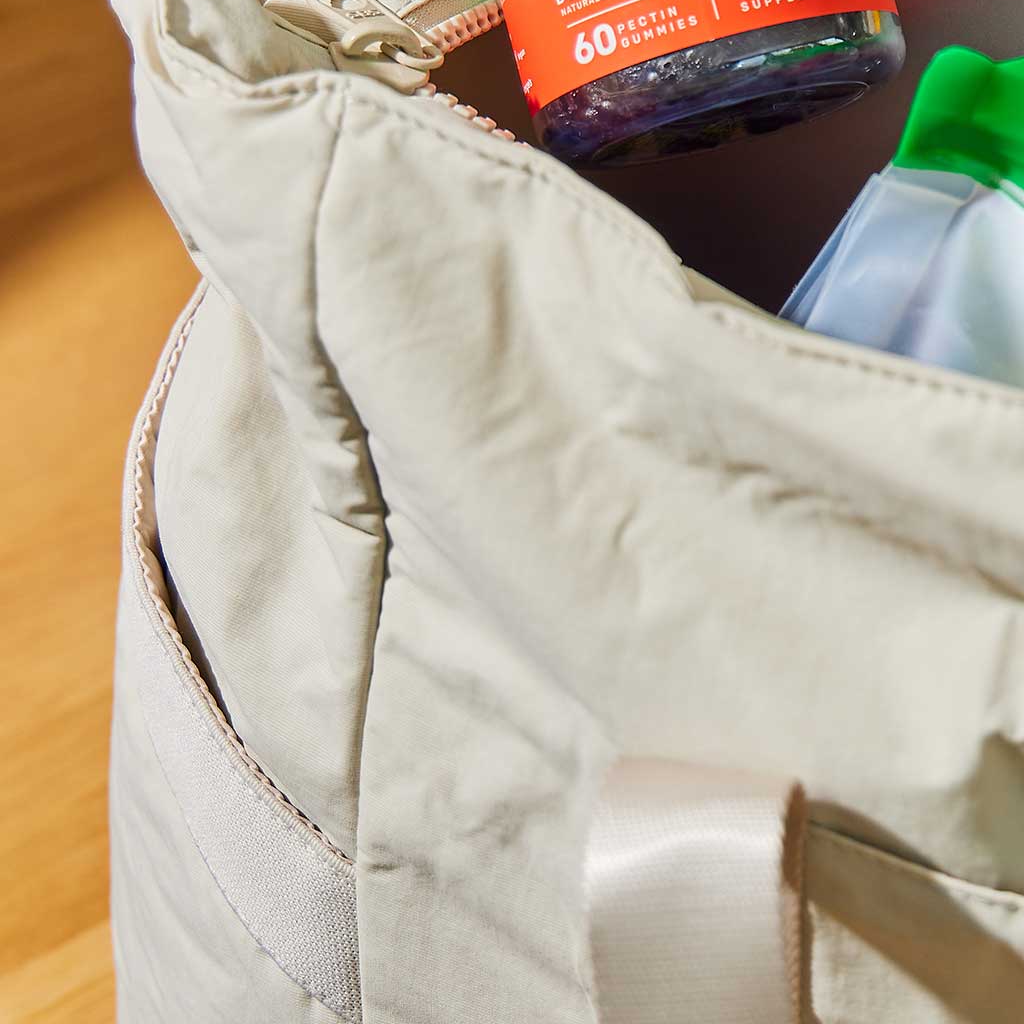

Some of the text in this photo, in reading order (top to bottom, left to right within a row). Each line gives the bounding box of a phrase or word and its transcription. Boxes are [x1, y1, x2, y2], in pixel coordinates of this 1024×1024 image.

[617, 6, 678, 32] PECTIN
[622, 16, 697, 48] GUMMIES
[574, 24, 616, 64] 60
